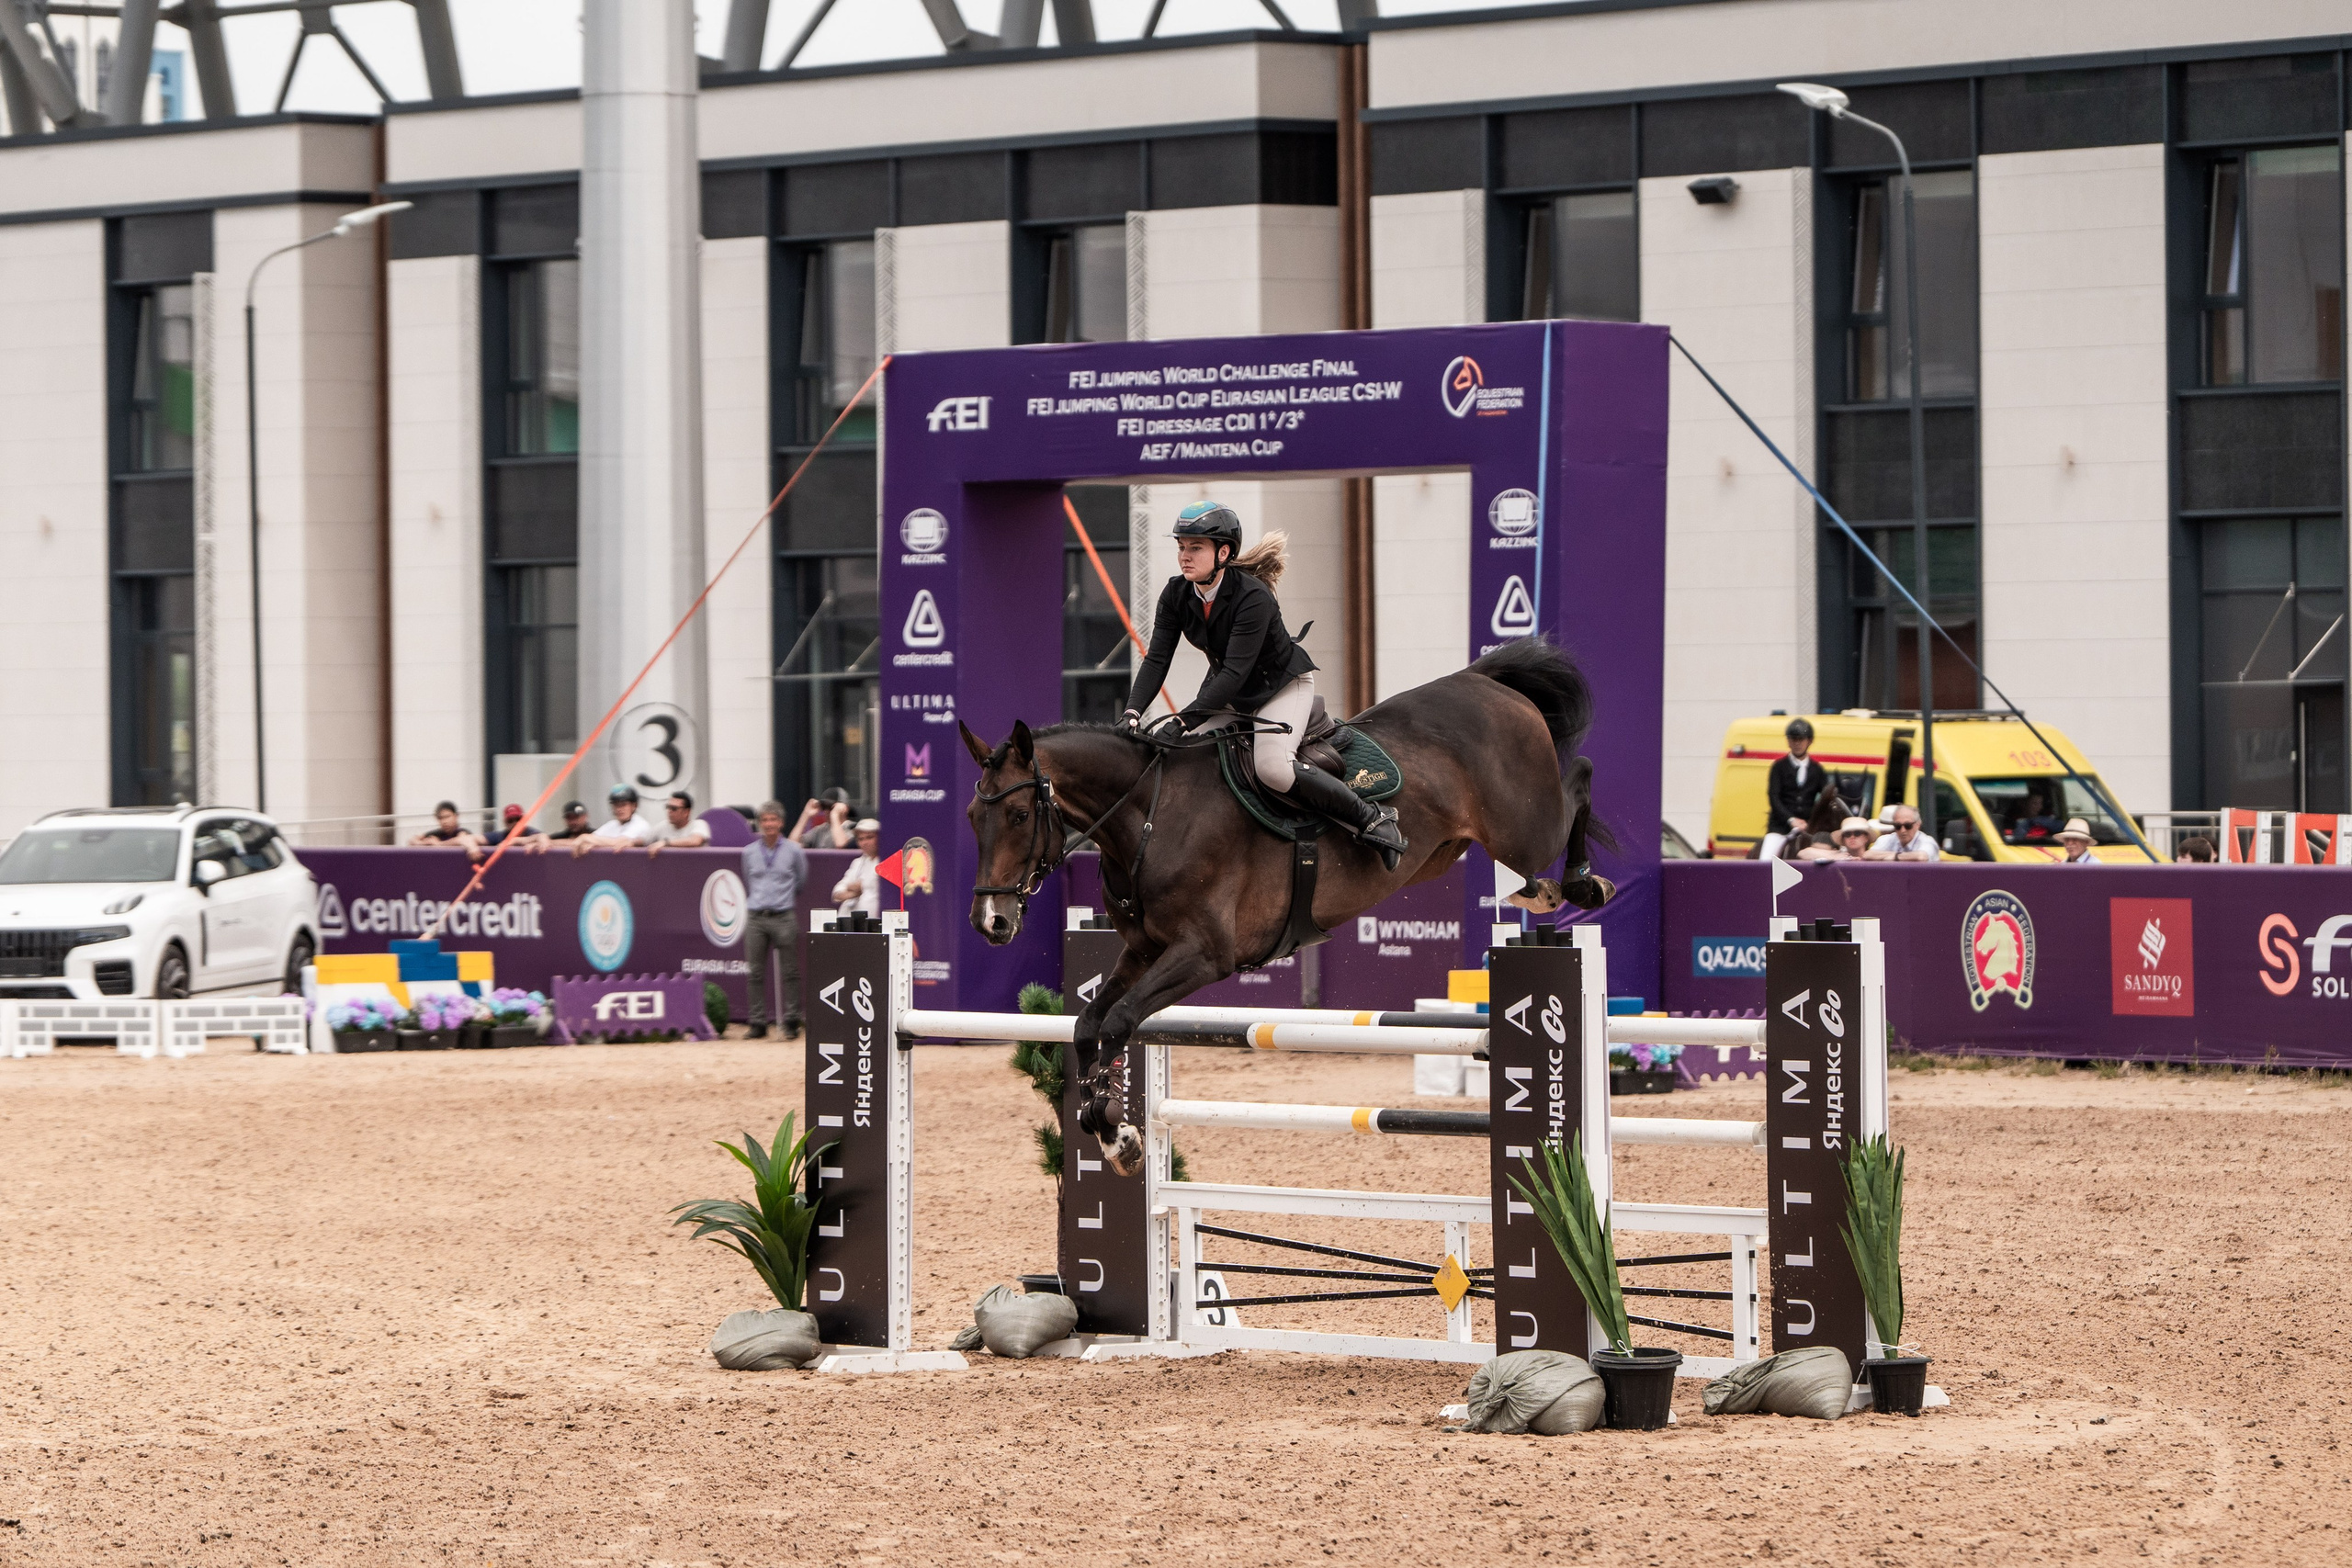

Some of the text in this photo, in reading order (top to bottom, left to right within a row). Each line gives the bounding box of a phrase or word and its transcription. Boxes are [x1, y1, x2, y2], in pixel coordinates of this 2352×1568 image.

[1027, 398, 1054, 415] FEI
[1351, 381, 1403, 401] CSI-W
[1069, 370, 1096, 389] FEI
[1116, 418, 1145, 436] FEI
[1146, 416, 1224, 434] DRESSAGE
[1225, 412, 1256, 432] CDI
[891, 694, 955, 709] ULTIMA
[637, 713, 682, 788] 3
[2008, 750, 2052, 768] 103
[350, 891, 543, 938] centercredit
[1984, 898, 2009, 908] ASIAN
[1378, 920, 1460, 940] WYNDHAM
[1378, 943, 1412, 956] Astana
[2124, 974, 2182, 998] SANDYQ
[2312, 976, 2352, 999] SOL
[1541, 995, 1566, 1043] Go
[852, 976, 875, 1127] Яндекс Go
[1818, 989, 1845, 1150] Яндекс Go
[819, 976, 845, 1302] ULTIMA
[1077, 973, 1103, 1292] ULTA
[1505, 994, 1539, 1348] ULTIMA
[1781, 988, 1815, 1336] ULTIMA
[1204, 1279, 1226, 1325] 3
